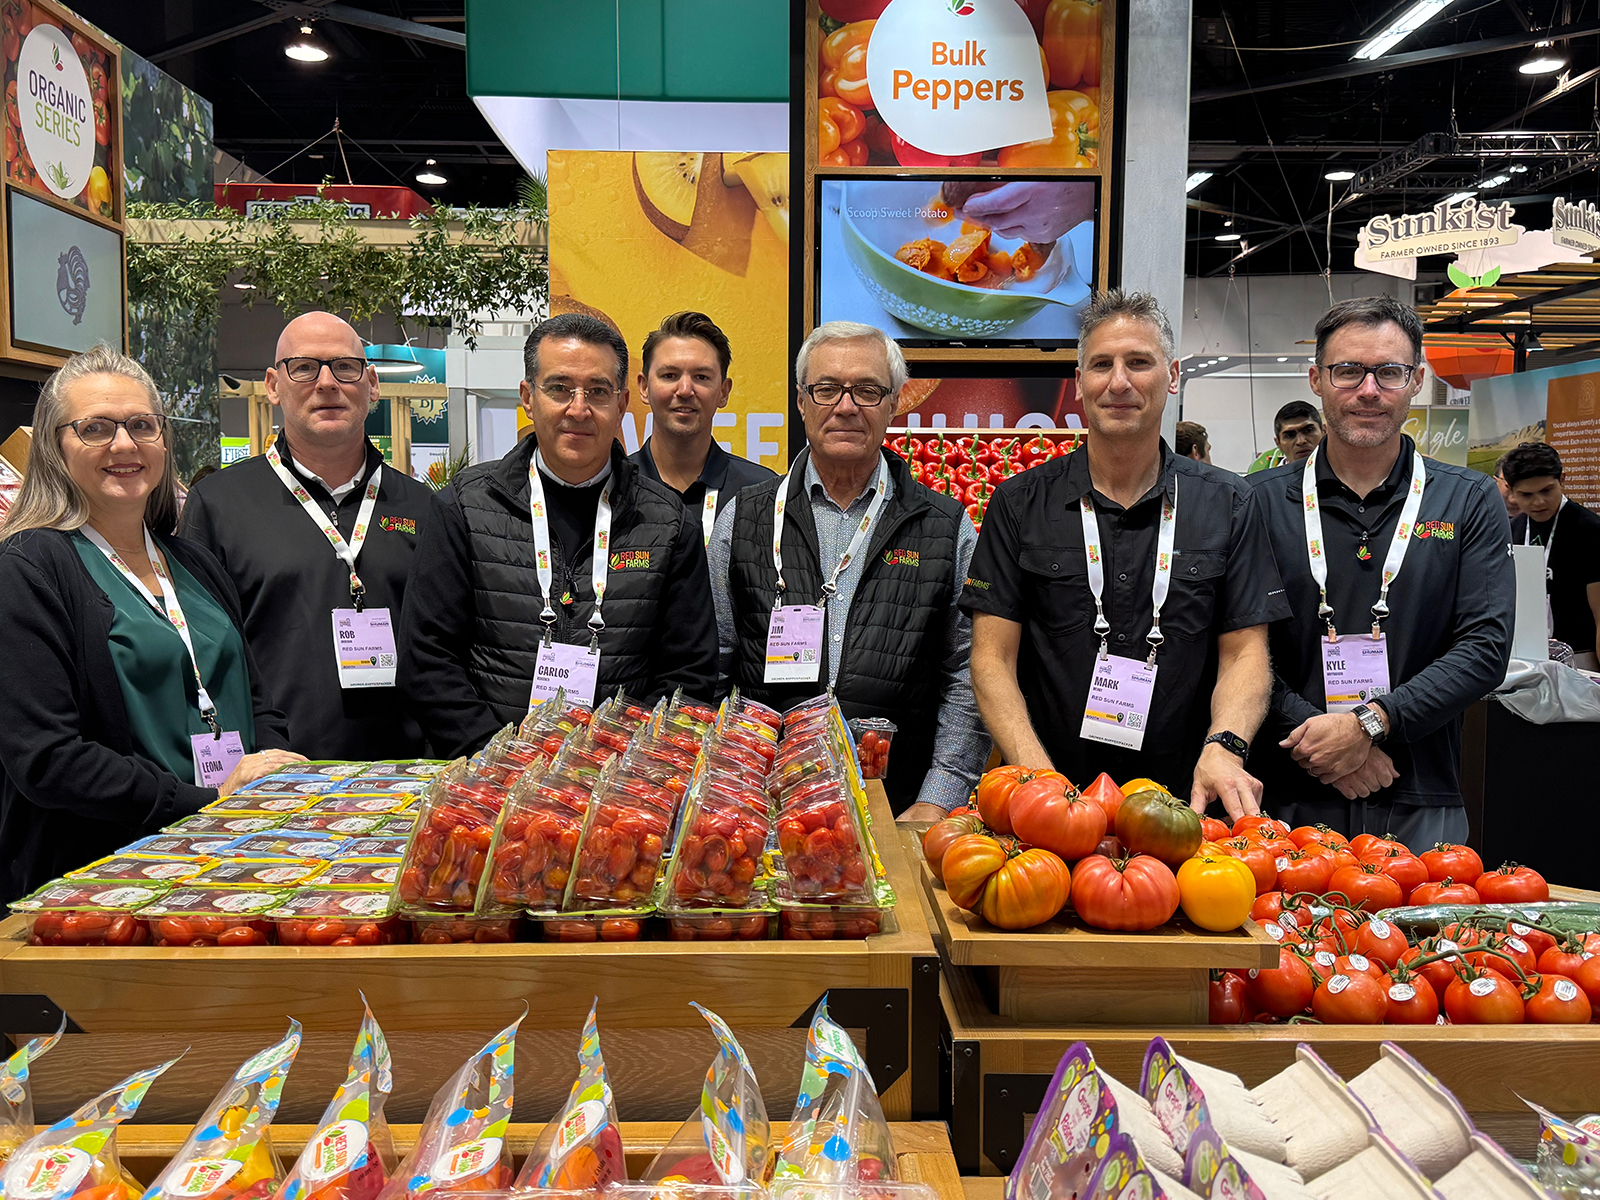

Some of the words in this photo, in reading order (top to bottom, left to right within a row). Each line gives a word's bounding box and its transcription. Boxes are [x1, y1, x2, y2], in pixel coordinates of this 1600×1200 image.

[931, 40, 987, 67] Bulk
[28, 69, 87, 124] ORGANIC
[892, 69, 1025, 110] Peppers
[34, 102, 81, 148] SERIES
[847, 206, 878, 220] Scoop
[880, 206, 912, 218] Sweet
[914, 207, 948, 218] Potato
[1368, 198, 1516, 249] Sunkist
[1380, 248, 1415, 259] FARMER
[1416, 243, 1450, 255] OWNED
[1451, 239, 1478, 250] SINCE
[1479, 237, 1500, 248] 1893
[1400, 417, 1465, 457] Single
[224, 448, 249, 461] FIRST
[403, 518, 416, 528] SUN
[1426, 520, 1440, 530] RED
[1440, 521, 1454, 532] SUN
[1431, 529, 1454, 540] FARMS
[620, 551, 635, 561] RED
[635, 550, 650, 560] SUN
[893, 549, 906, 558] RED
[906, 550, 920, 559] SUN
[625, 559, 650, 569] FARMS
[899, 556, 920, 567] FARMS
[339, 630, 356, 639] ROB
[770, 625, 784, 635] JIM
[538, 665, 570, 679] CARLOS
[1326, 660, 1347, 671] KYLE
[1093, 675, 1120, 691] MARK
[1091, 694, 1103, 702] RED
[1115, 700, 1135, 708] FARMS
[201, 760, 224, 774] LEONA
[1077, 1087, 1093, 1119] Grape
[1165, 1082, 1183, 1114] Grape
[335, 1134, 348, 1152] RED
[323, 1144, 336, 1173] FARMS
[335, 1150, 348, 1168] SUN
[207, 1170, 224, 1181] RED
